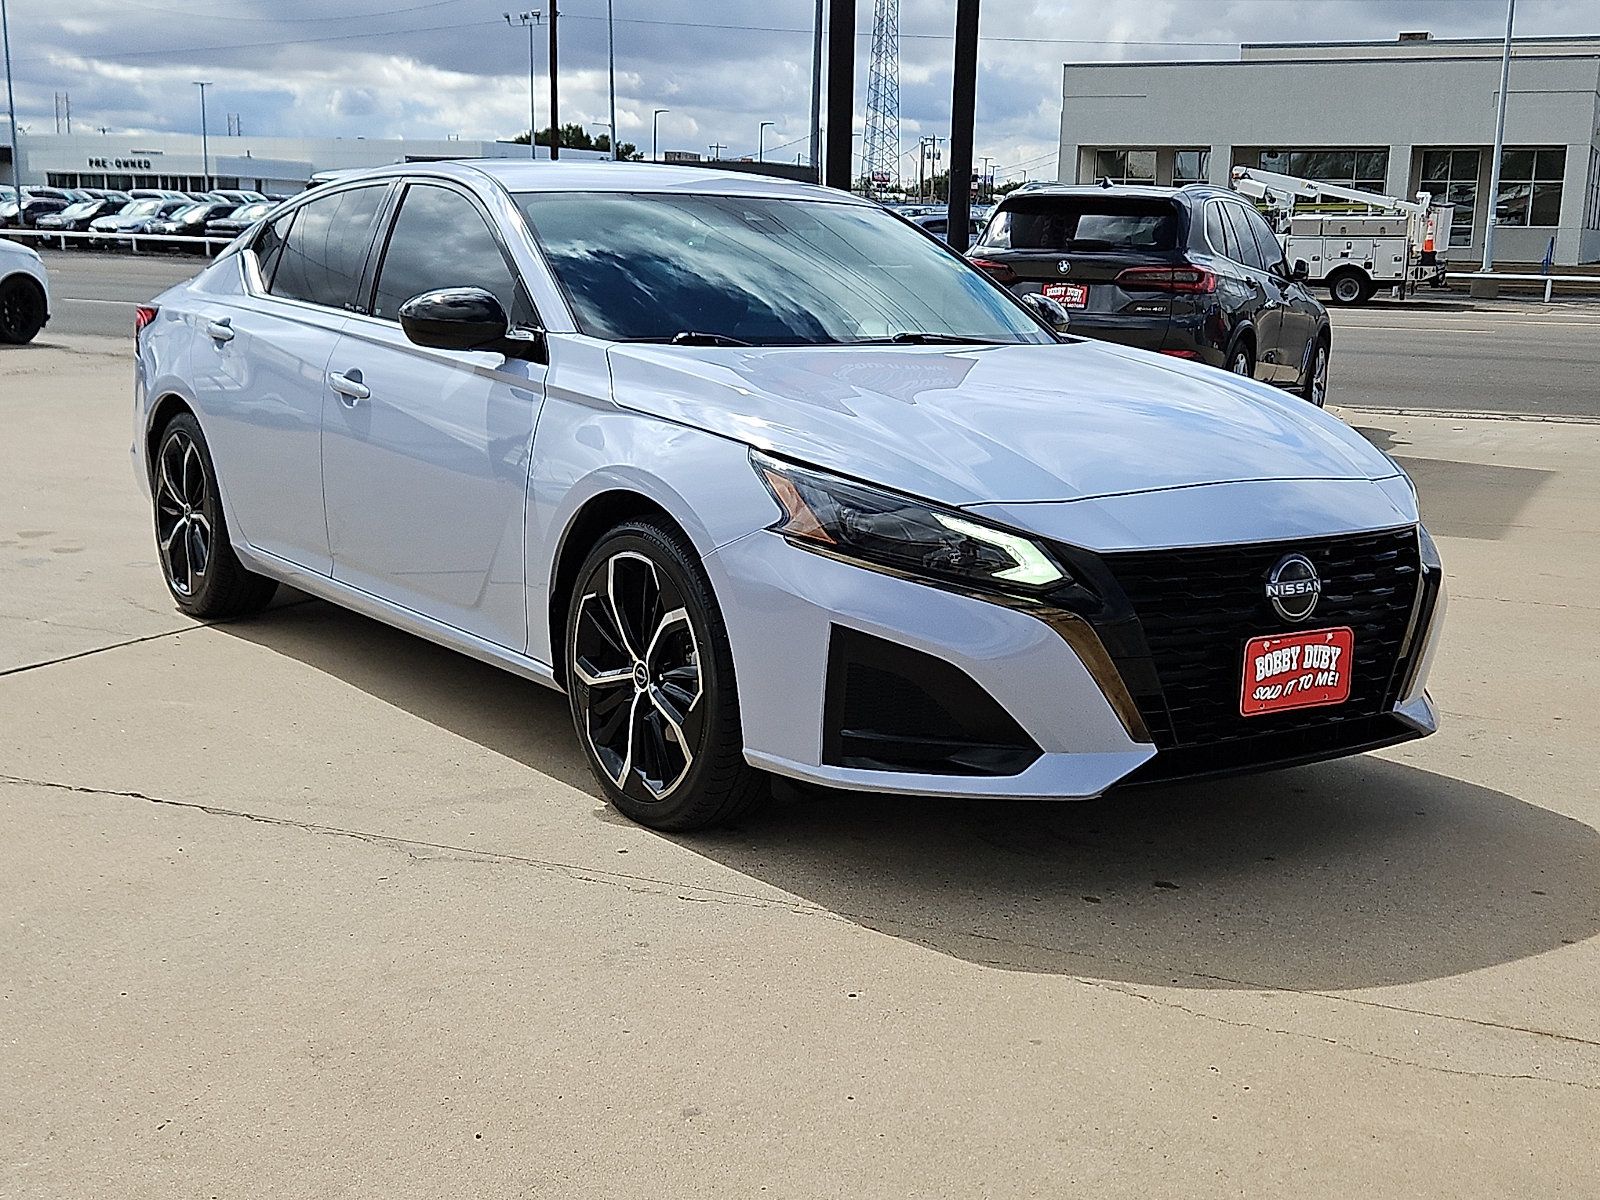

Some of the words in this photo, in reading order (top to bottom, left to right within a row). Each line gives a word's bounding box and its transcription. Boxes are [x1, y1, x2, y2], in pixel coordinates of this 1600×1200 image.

[1267, 580, 1321, 597] NISSAN
[1255, 645, 1301, 682] BOBBY
[1302, 644, 1342, 671] DUBY
[1252, 685, 1283, 701] SOLD
[1282, 679, 1298, 697] IT
[1298, 672, 1314, 691] TO
[1314, 670, 1340, 688] ME!
